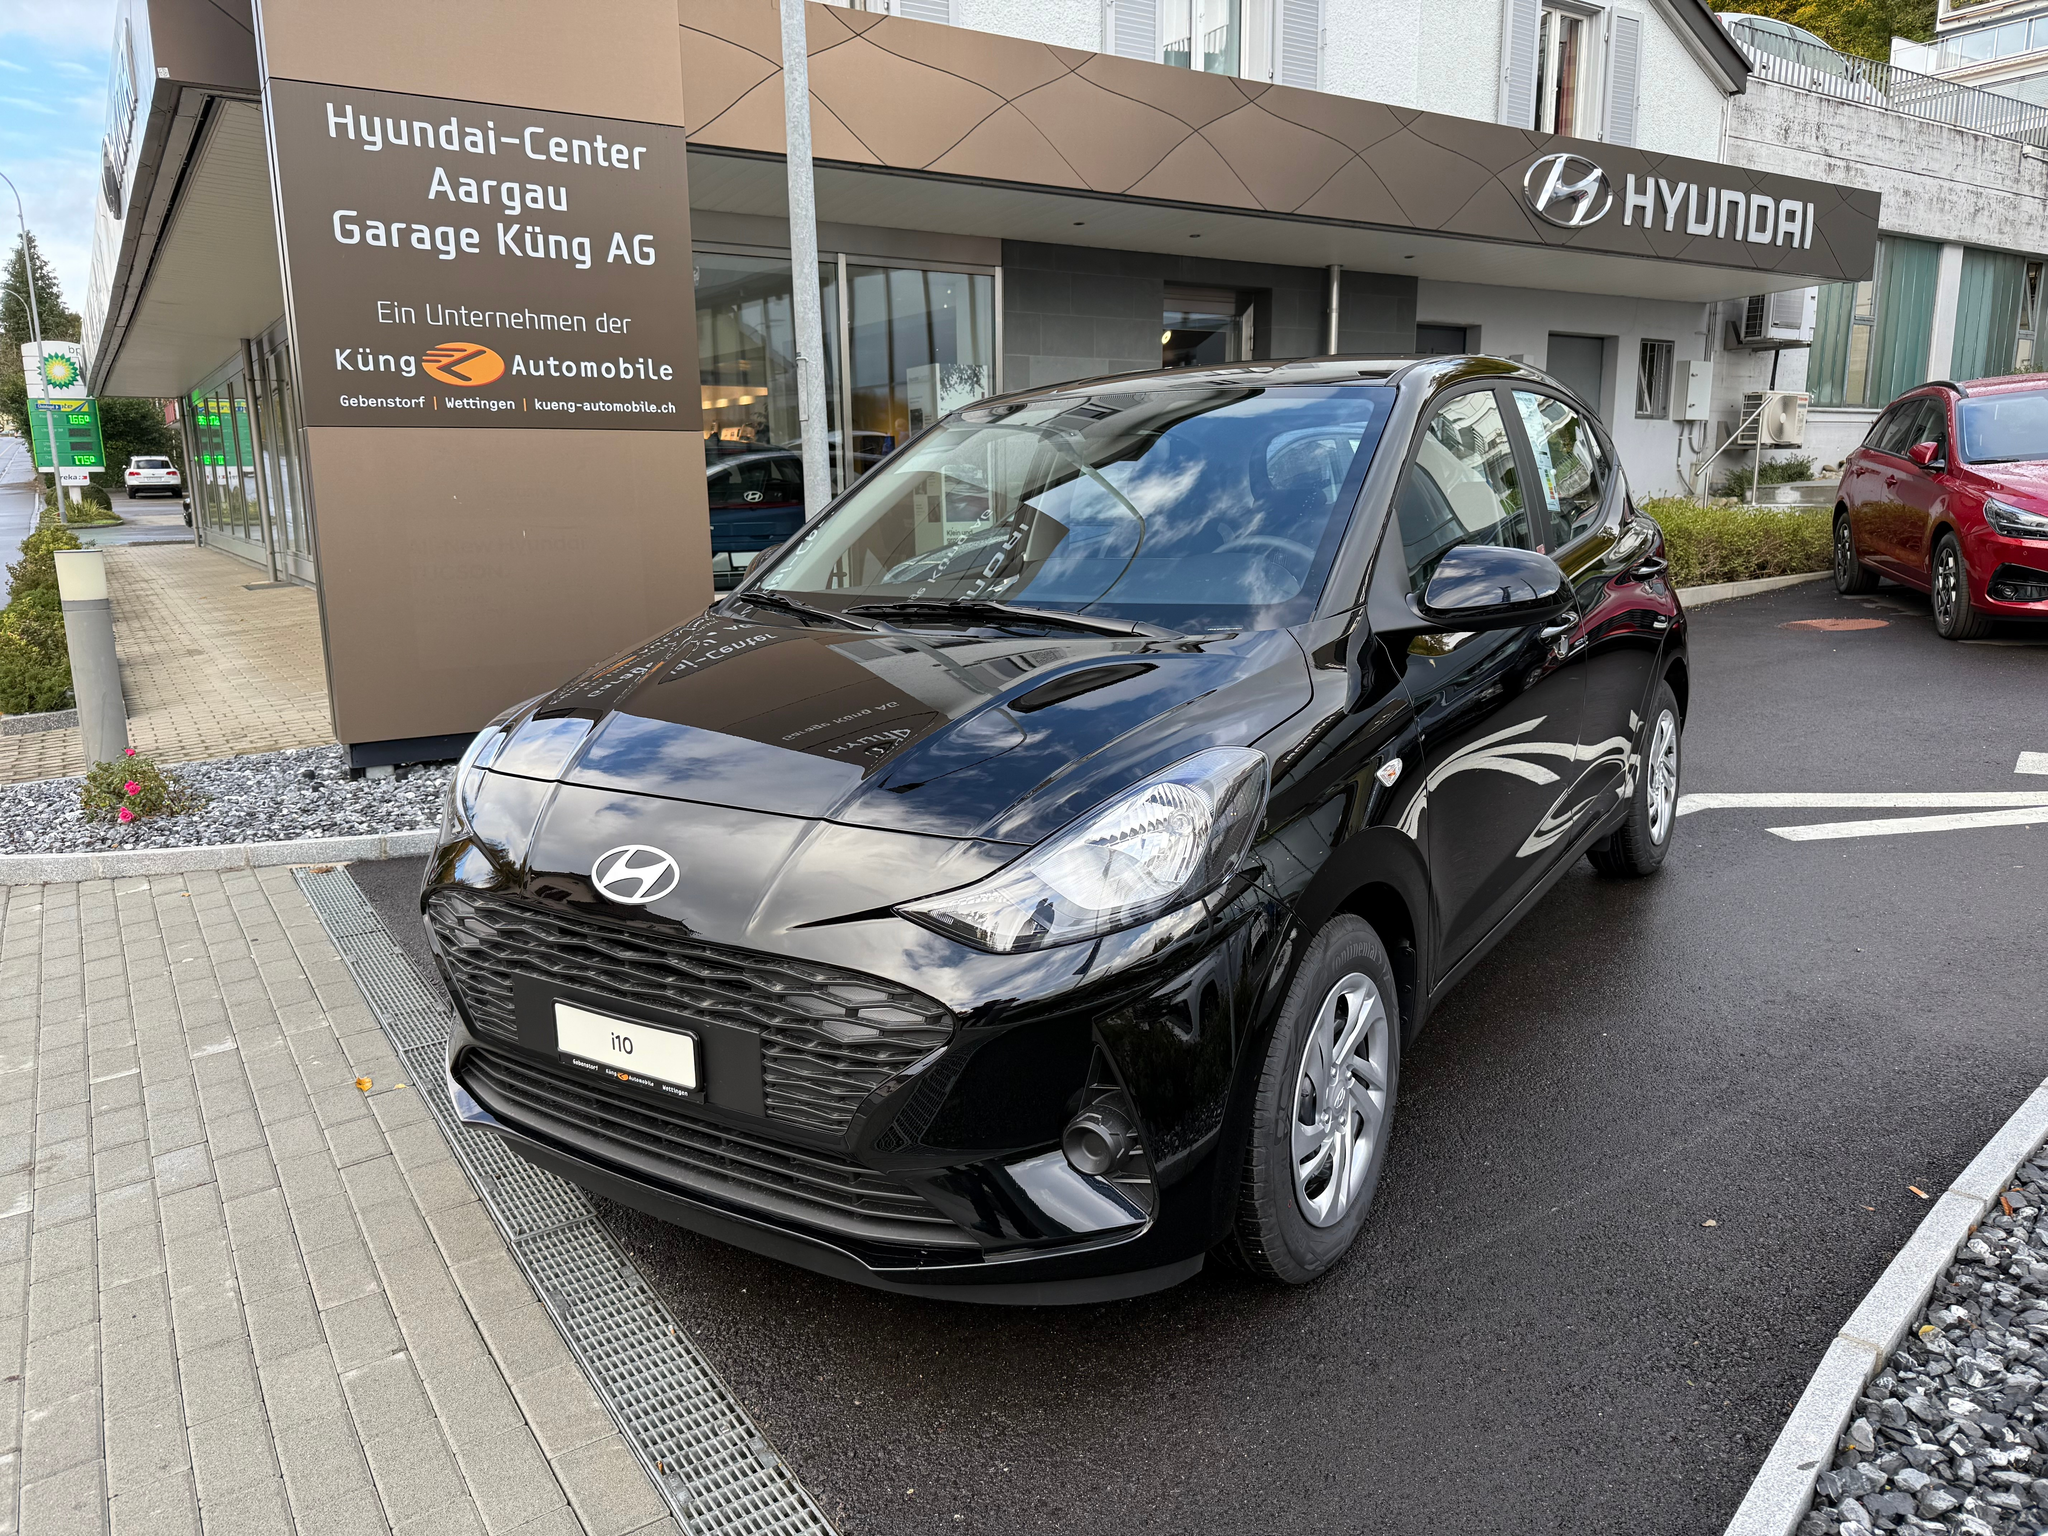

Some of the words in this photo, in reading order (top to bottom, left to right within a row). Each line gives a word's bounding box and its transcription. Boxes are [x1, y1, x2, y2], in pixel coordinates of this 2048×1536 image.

[326, 102, 647, 170] Hyundai-Center
[428, 166, 568, 216] Aargau
[1623, 173, 1815, 249] HYUNDAI
[332, 209, 480, 260] Garage
[497, 222, 592, 269] Küng
[606, 231, 657, 266] AG
[377, 300, 416, 325] Ein
[426, 303, 587, 332] Unternehmen
[595, 312, 632, 334] der
[335, 348, 416, 377] Küng
[511, 354, 674, 381] Automobile
[339, 394, 426, 408] Gebenstorf
[445, 396, 516, 411] Wettingen
[534, 398, 677, 414] kueng-automobile.ch
[611, 1032, 633, 1054] i10
[572, 1058, 599, 1071] Gebenstorf
